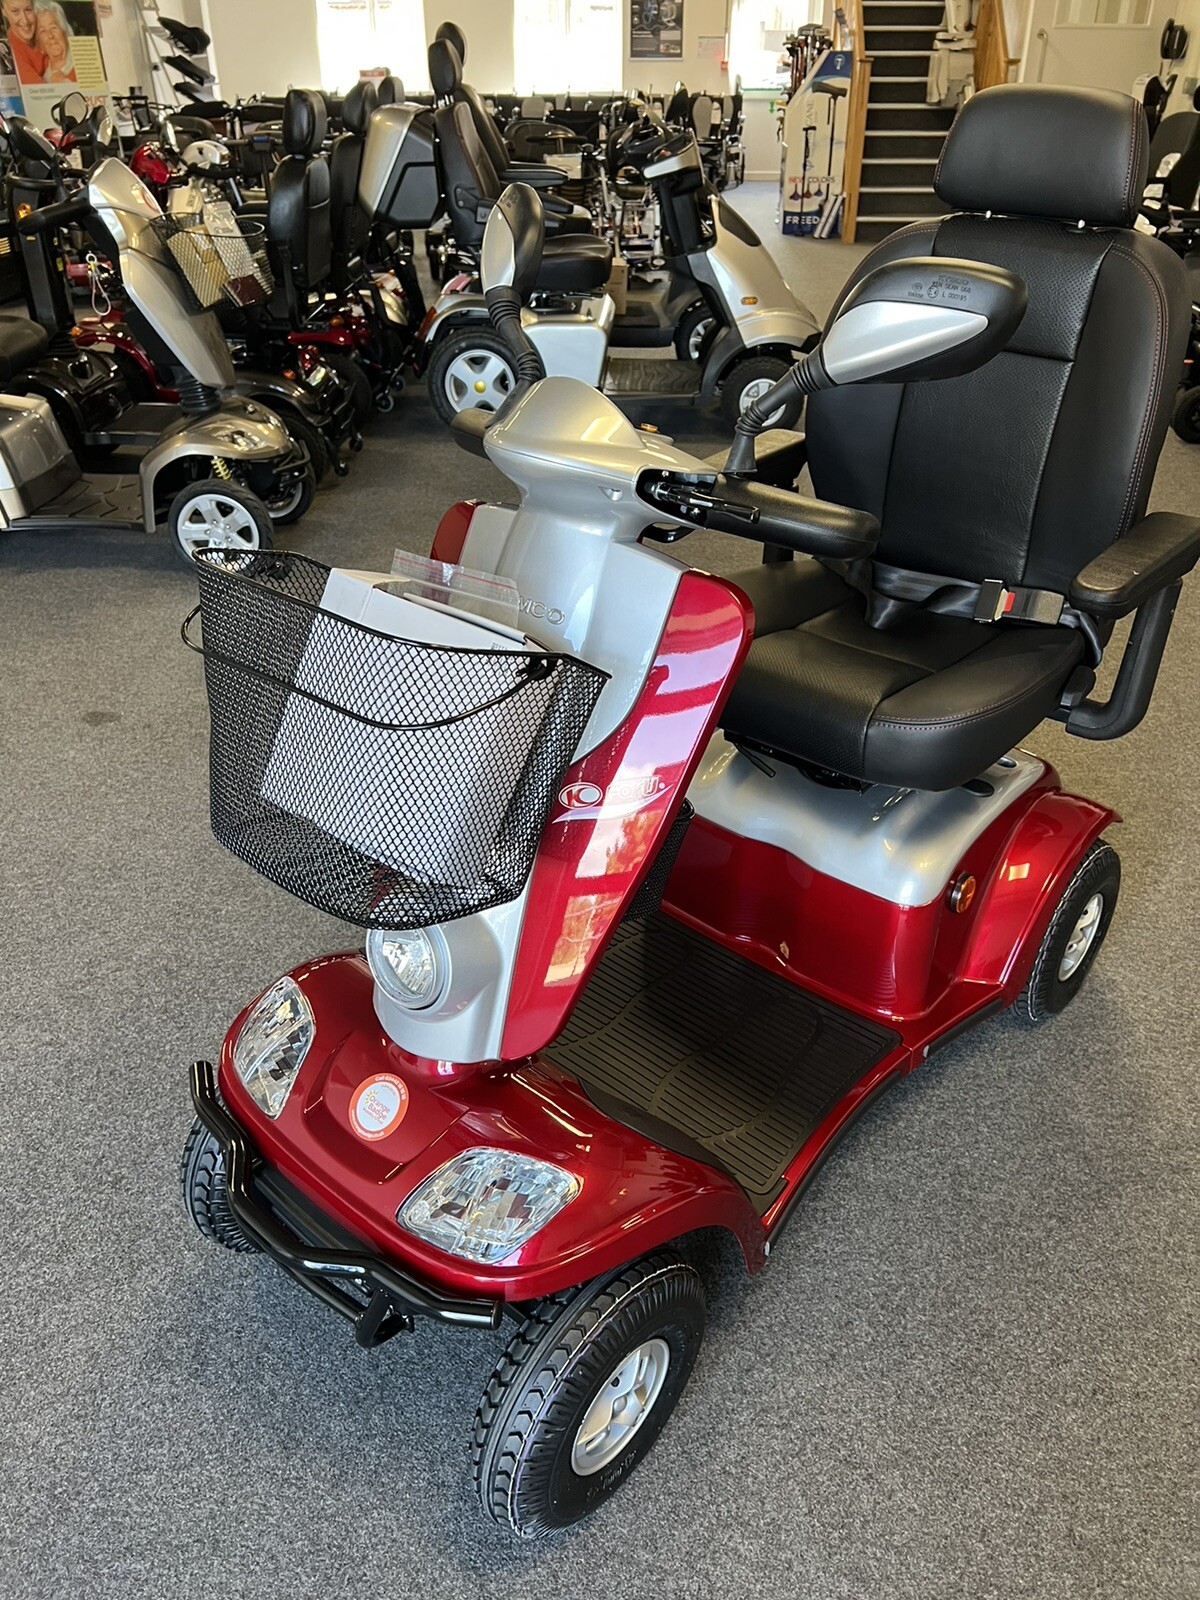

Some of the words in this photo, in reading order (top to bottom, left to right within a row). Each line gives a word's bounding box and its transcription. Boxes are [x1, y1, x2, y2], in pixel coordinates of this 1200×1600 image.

[84, 95, 108, 106] RUST
[785, 215, 820, 225] FREED
[518, 595, 566, 625] MCO
[367, 1103, 387, 1120] Badge
[369, 1095, 391, 1114] Orange
